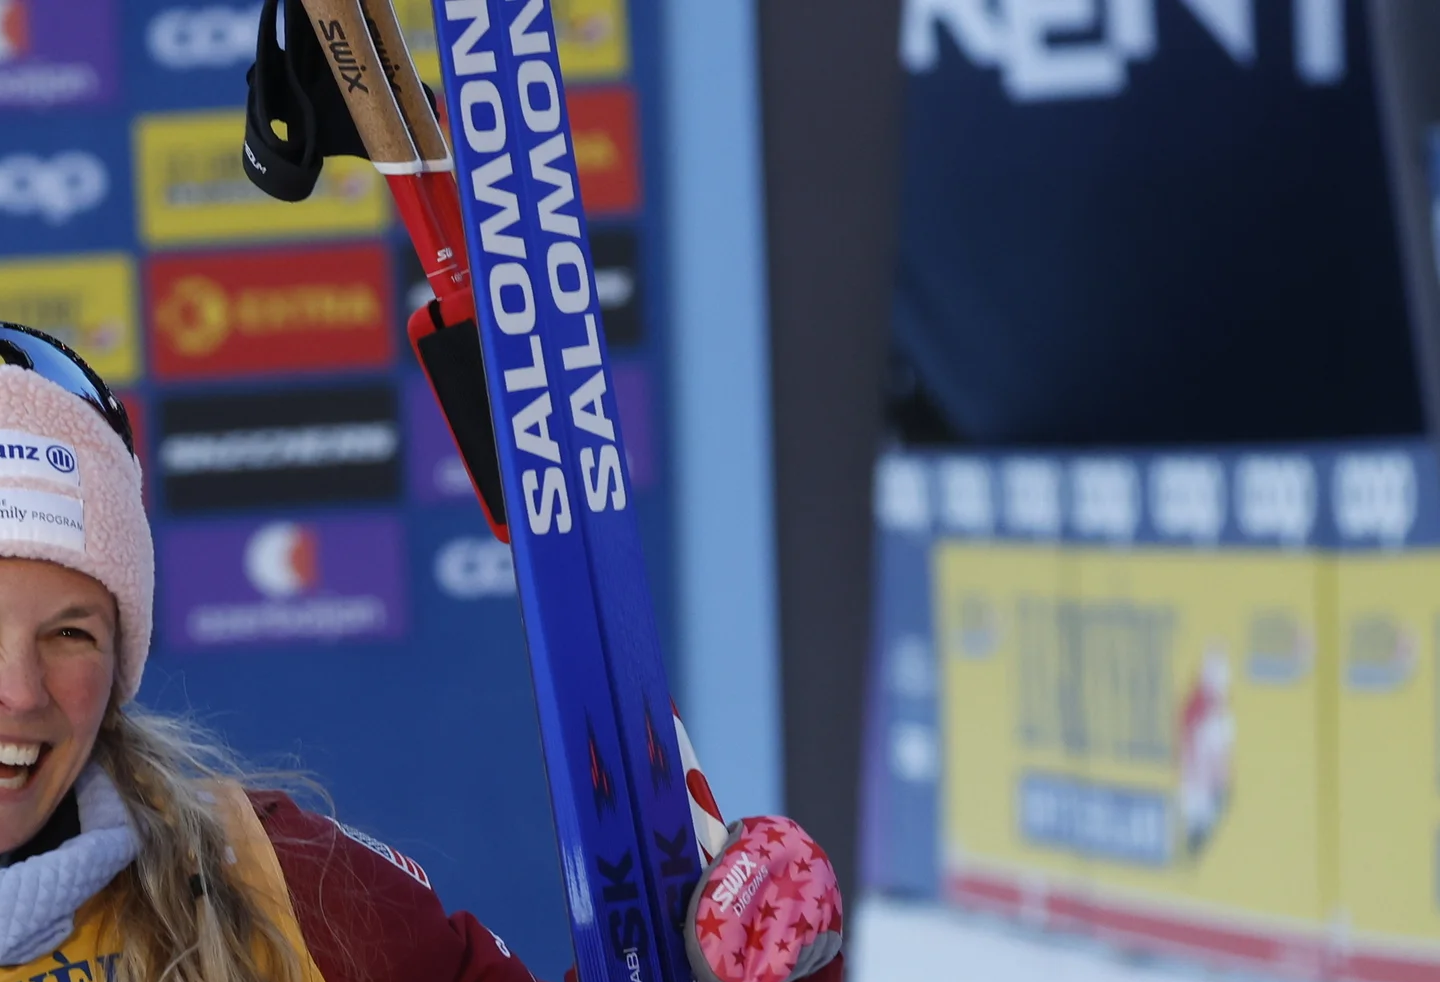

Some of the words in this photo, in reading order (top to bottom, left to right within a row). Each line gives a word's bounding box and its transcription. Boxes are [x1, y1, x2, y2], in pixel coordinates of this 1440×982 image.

[446, 0, 572, 535] SALOMON
[509, 0, 627, 512] SALOMON
[712, 852, 757, 913] SWIX
